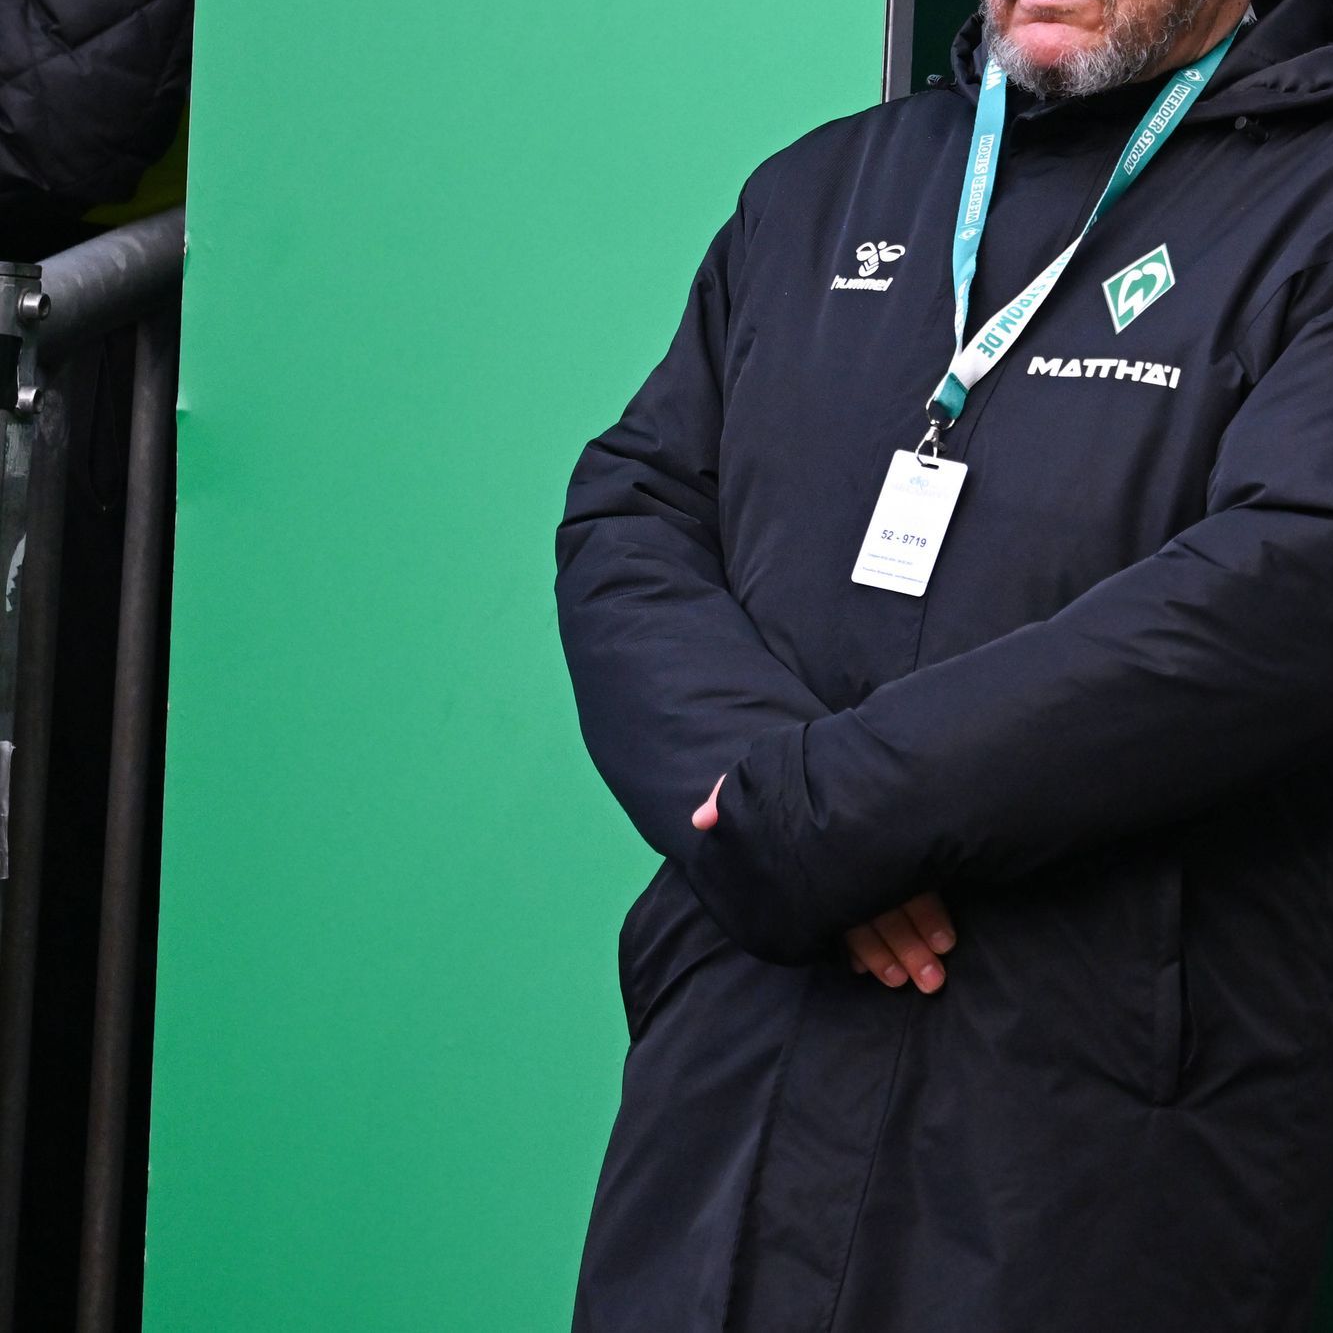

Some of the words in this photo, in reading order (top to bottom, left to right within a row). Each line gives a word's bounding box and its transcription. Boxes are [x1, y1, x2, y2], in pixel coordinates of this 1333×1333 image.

[1149, 84, 1190, 134] WERDER
[975, 134, 995, 175] STROM
[1124, 130, 1156, 174] STROM
[965, 175, 987, 224] WERDER
[830, 274, 894, 292] hummel
[1026, 356, 1181, 389] MATTHÄI
[880, 529, 894, 541] 52
[902, 533, 927, 548] 9719
